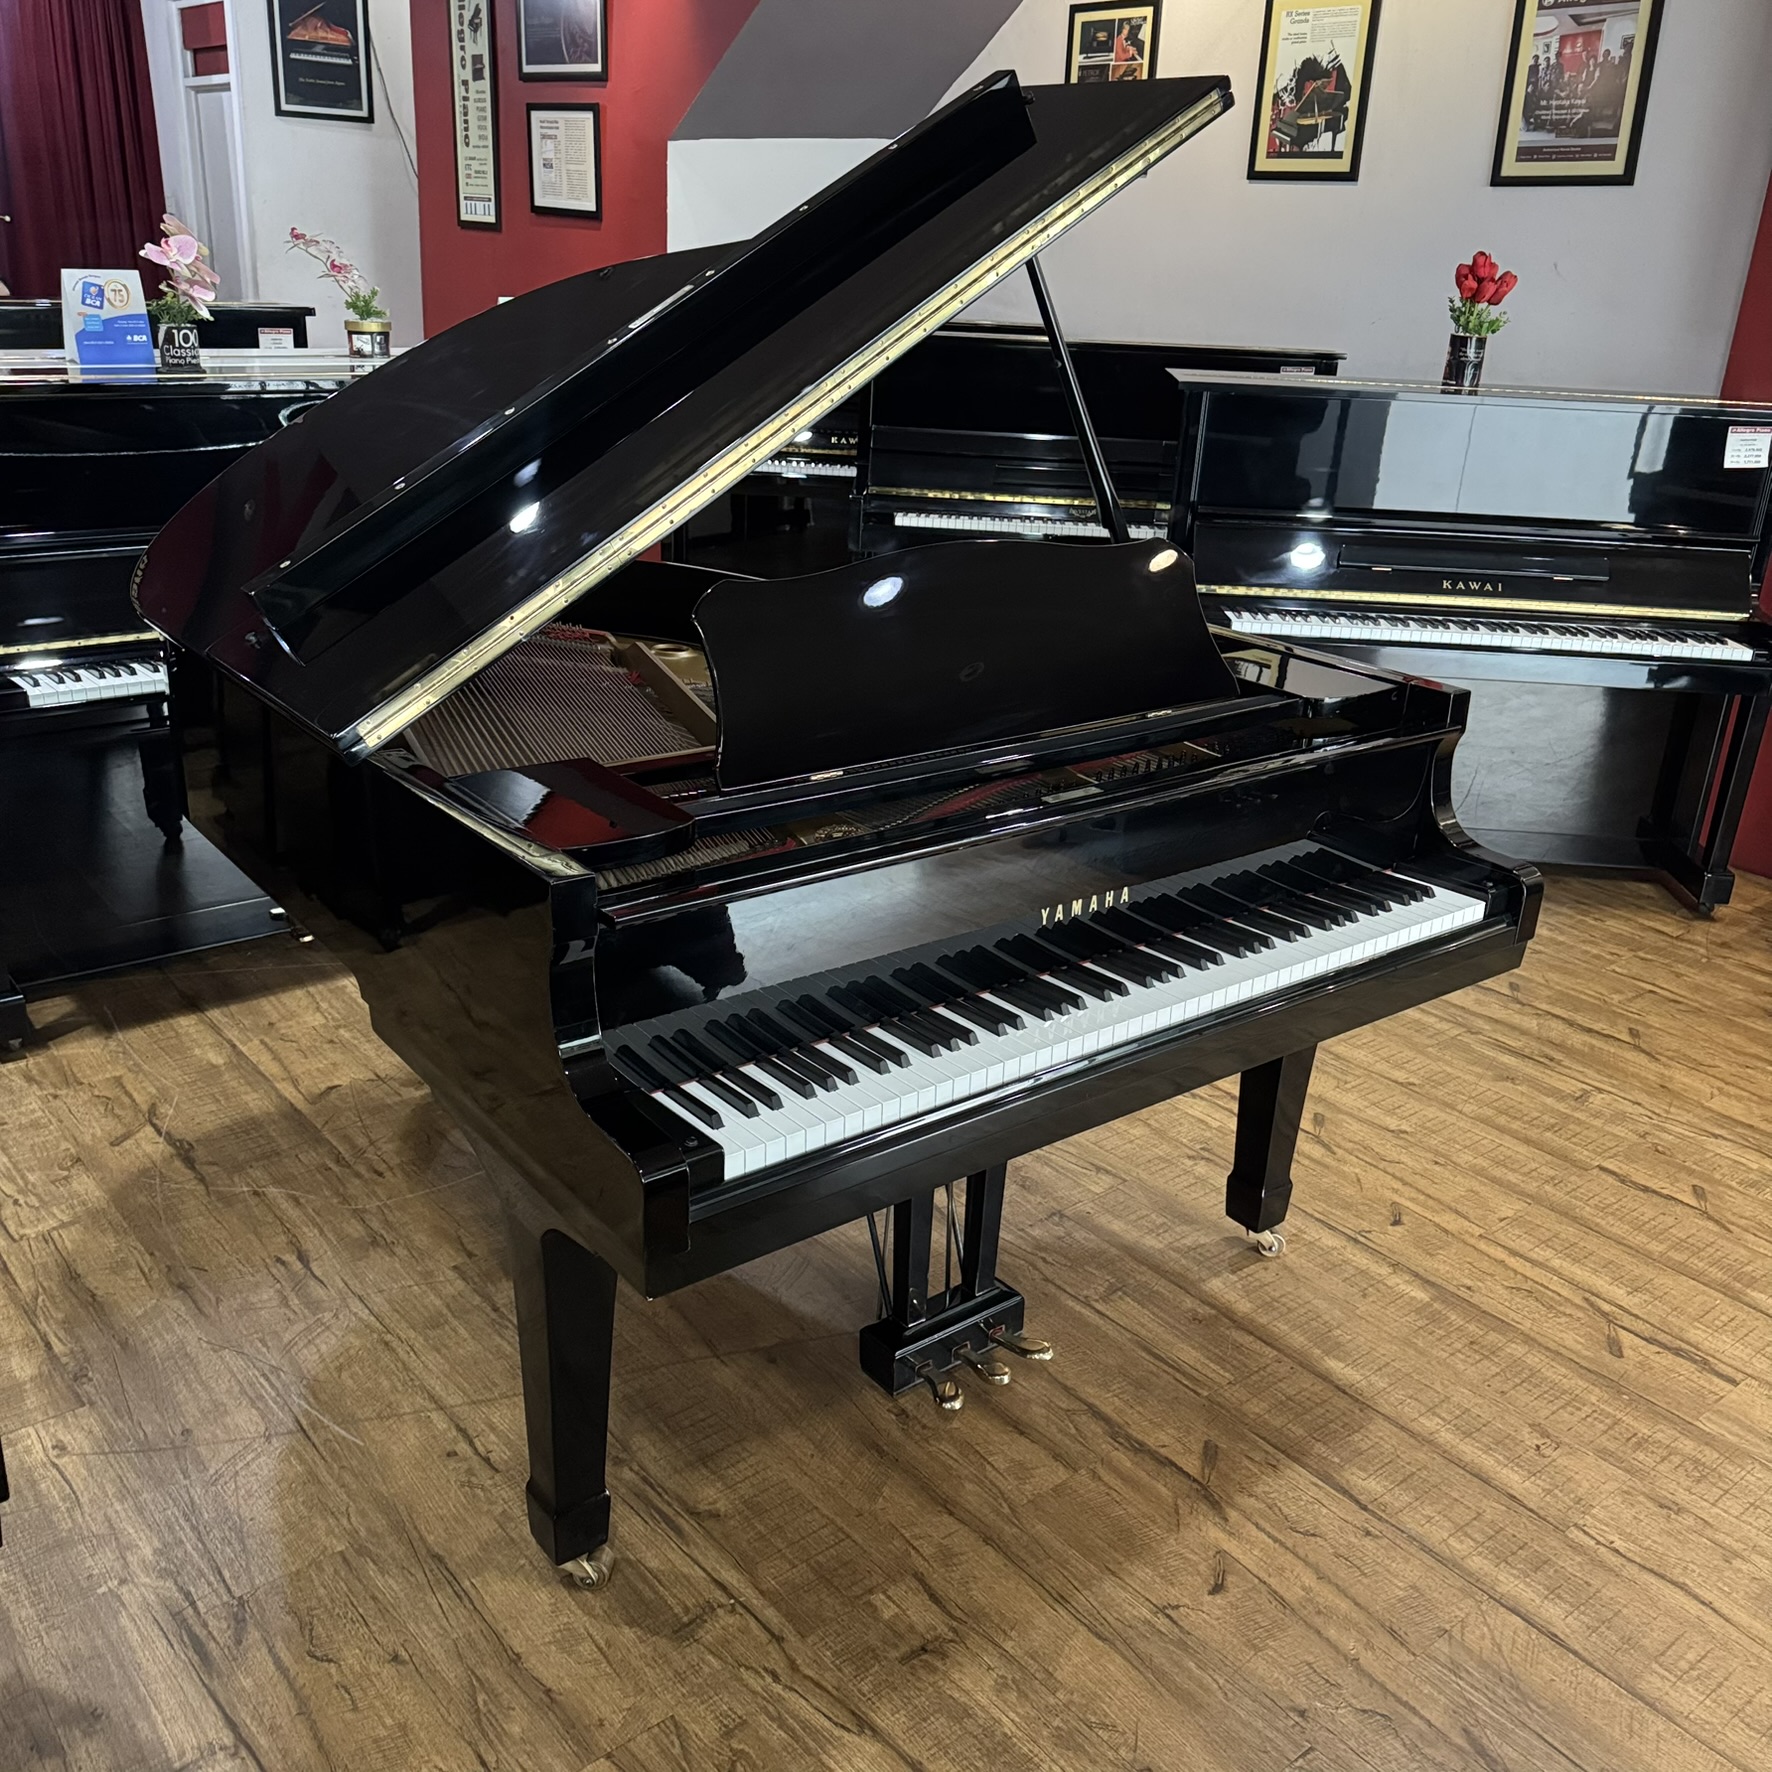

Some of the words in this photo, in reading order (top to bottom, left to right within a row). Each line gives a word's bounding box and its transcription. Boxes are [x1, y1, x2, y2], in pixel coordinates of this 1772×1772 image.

[1294, 10, 1310, 18] Series
[461, 79, 470, 148] Piano
[85, 298, 101, 307] BCA
[110, 288, 125, 304] 75
[133, 334, 148, 342] BCA
[171, 329, 199, 348] 100
[1442, 579, 1503, 592] KAWAI
[1041, 886, 1129, 926] YAMAHA
